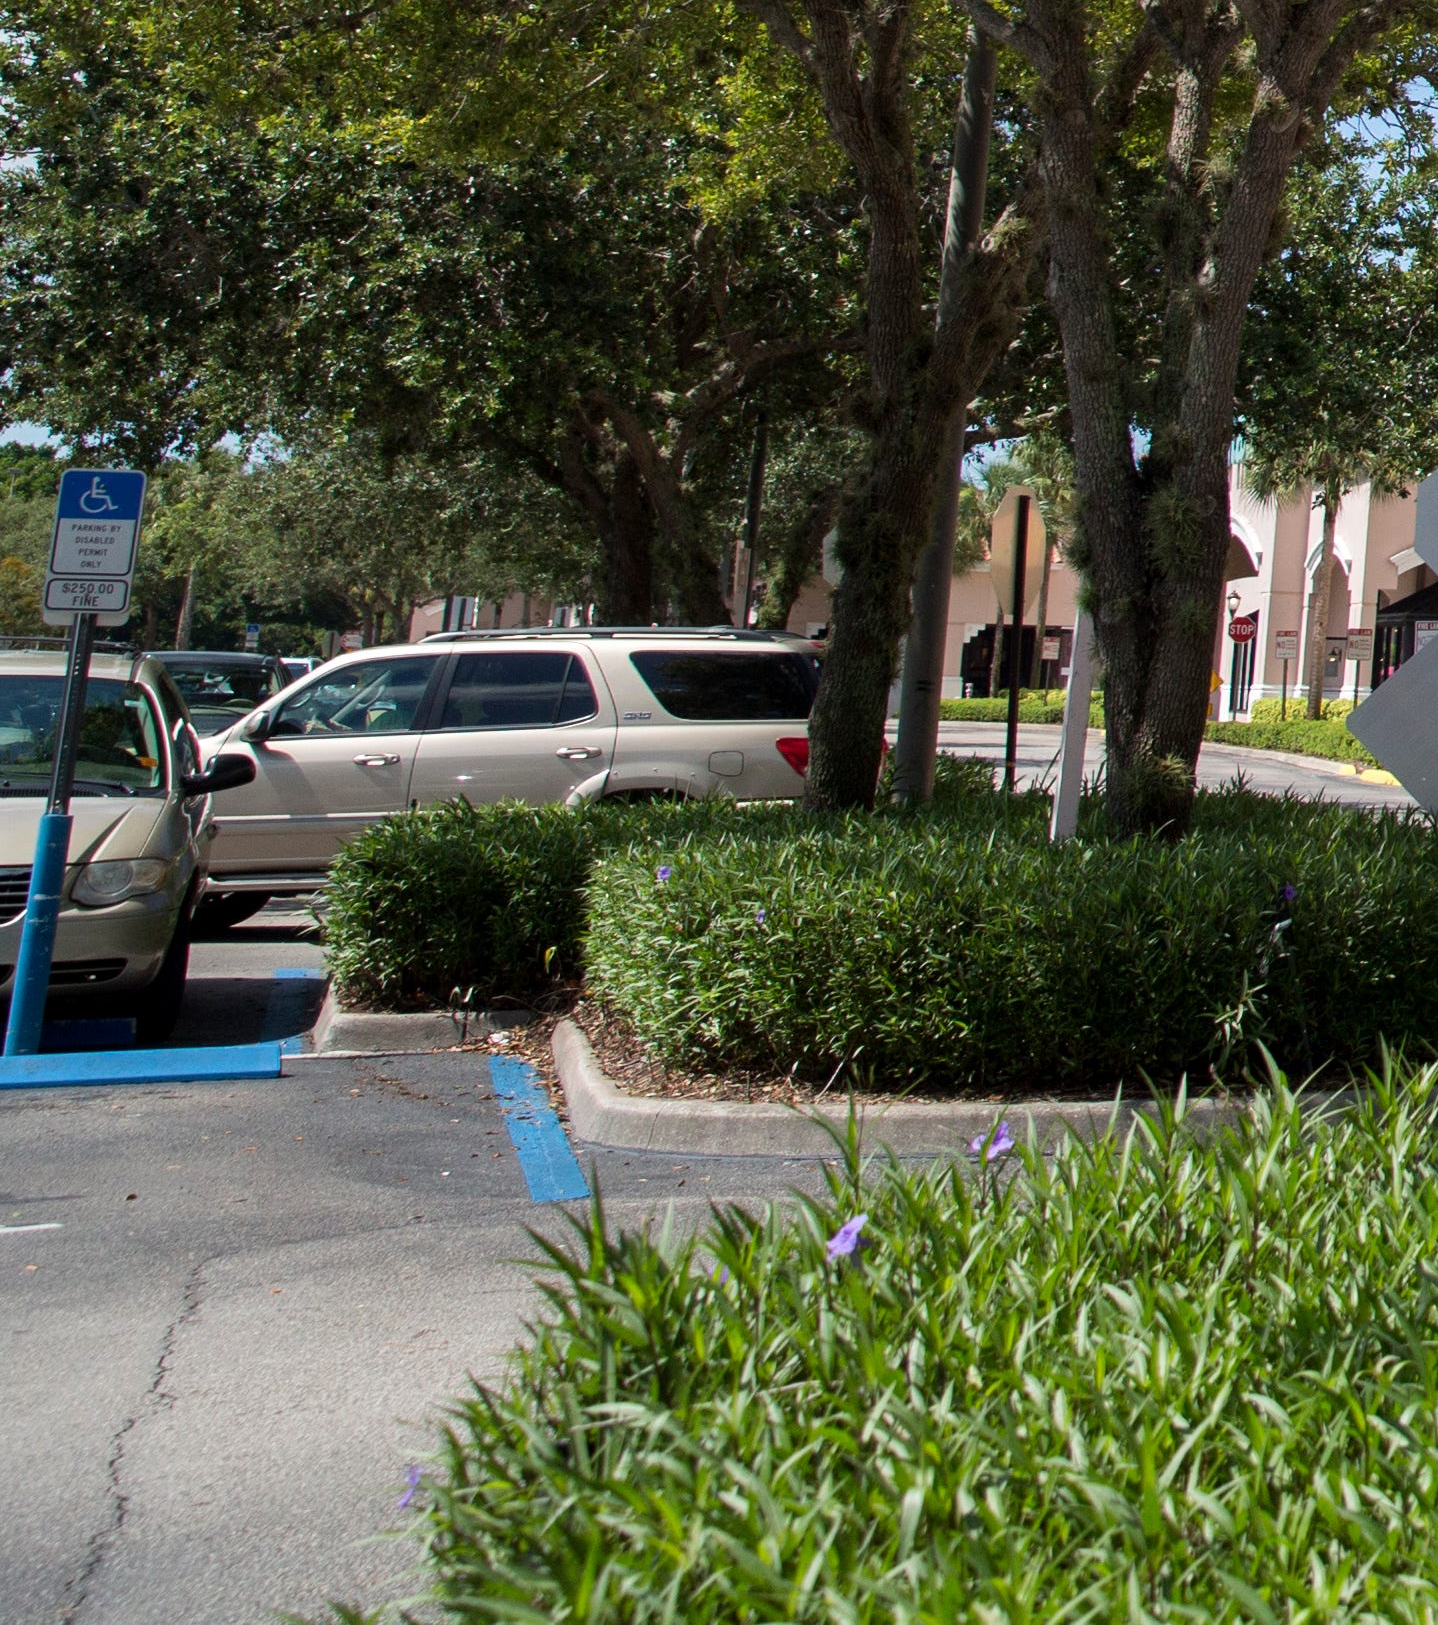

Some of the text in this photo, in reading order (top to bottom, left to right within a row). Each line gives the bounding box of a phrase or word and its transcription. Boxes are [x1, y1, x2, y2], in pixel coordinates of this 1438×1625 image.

[72, 525, 107, 533] PARKING
[75, 536, 115, 544] DISABLED
[78, 548, 108, 557] PERMIT
[80, 560, 102, 569] ONLY
[61, 582, 114, 595] $250.00
[72, 595, 99, 607] FINE
[1229, 624, 1254, 635] STOP
